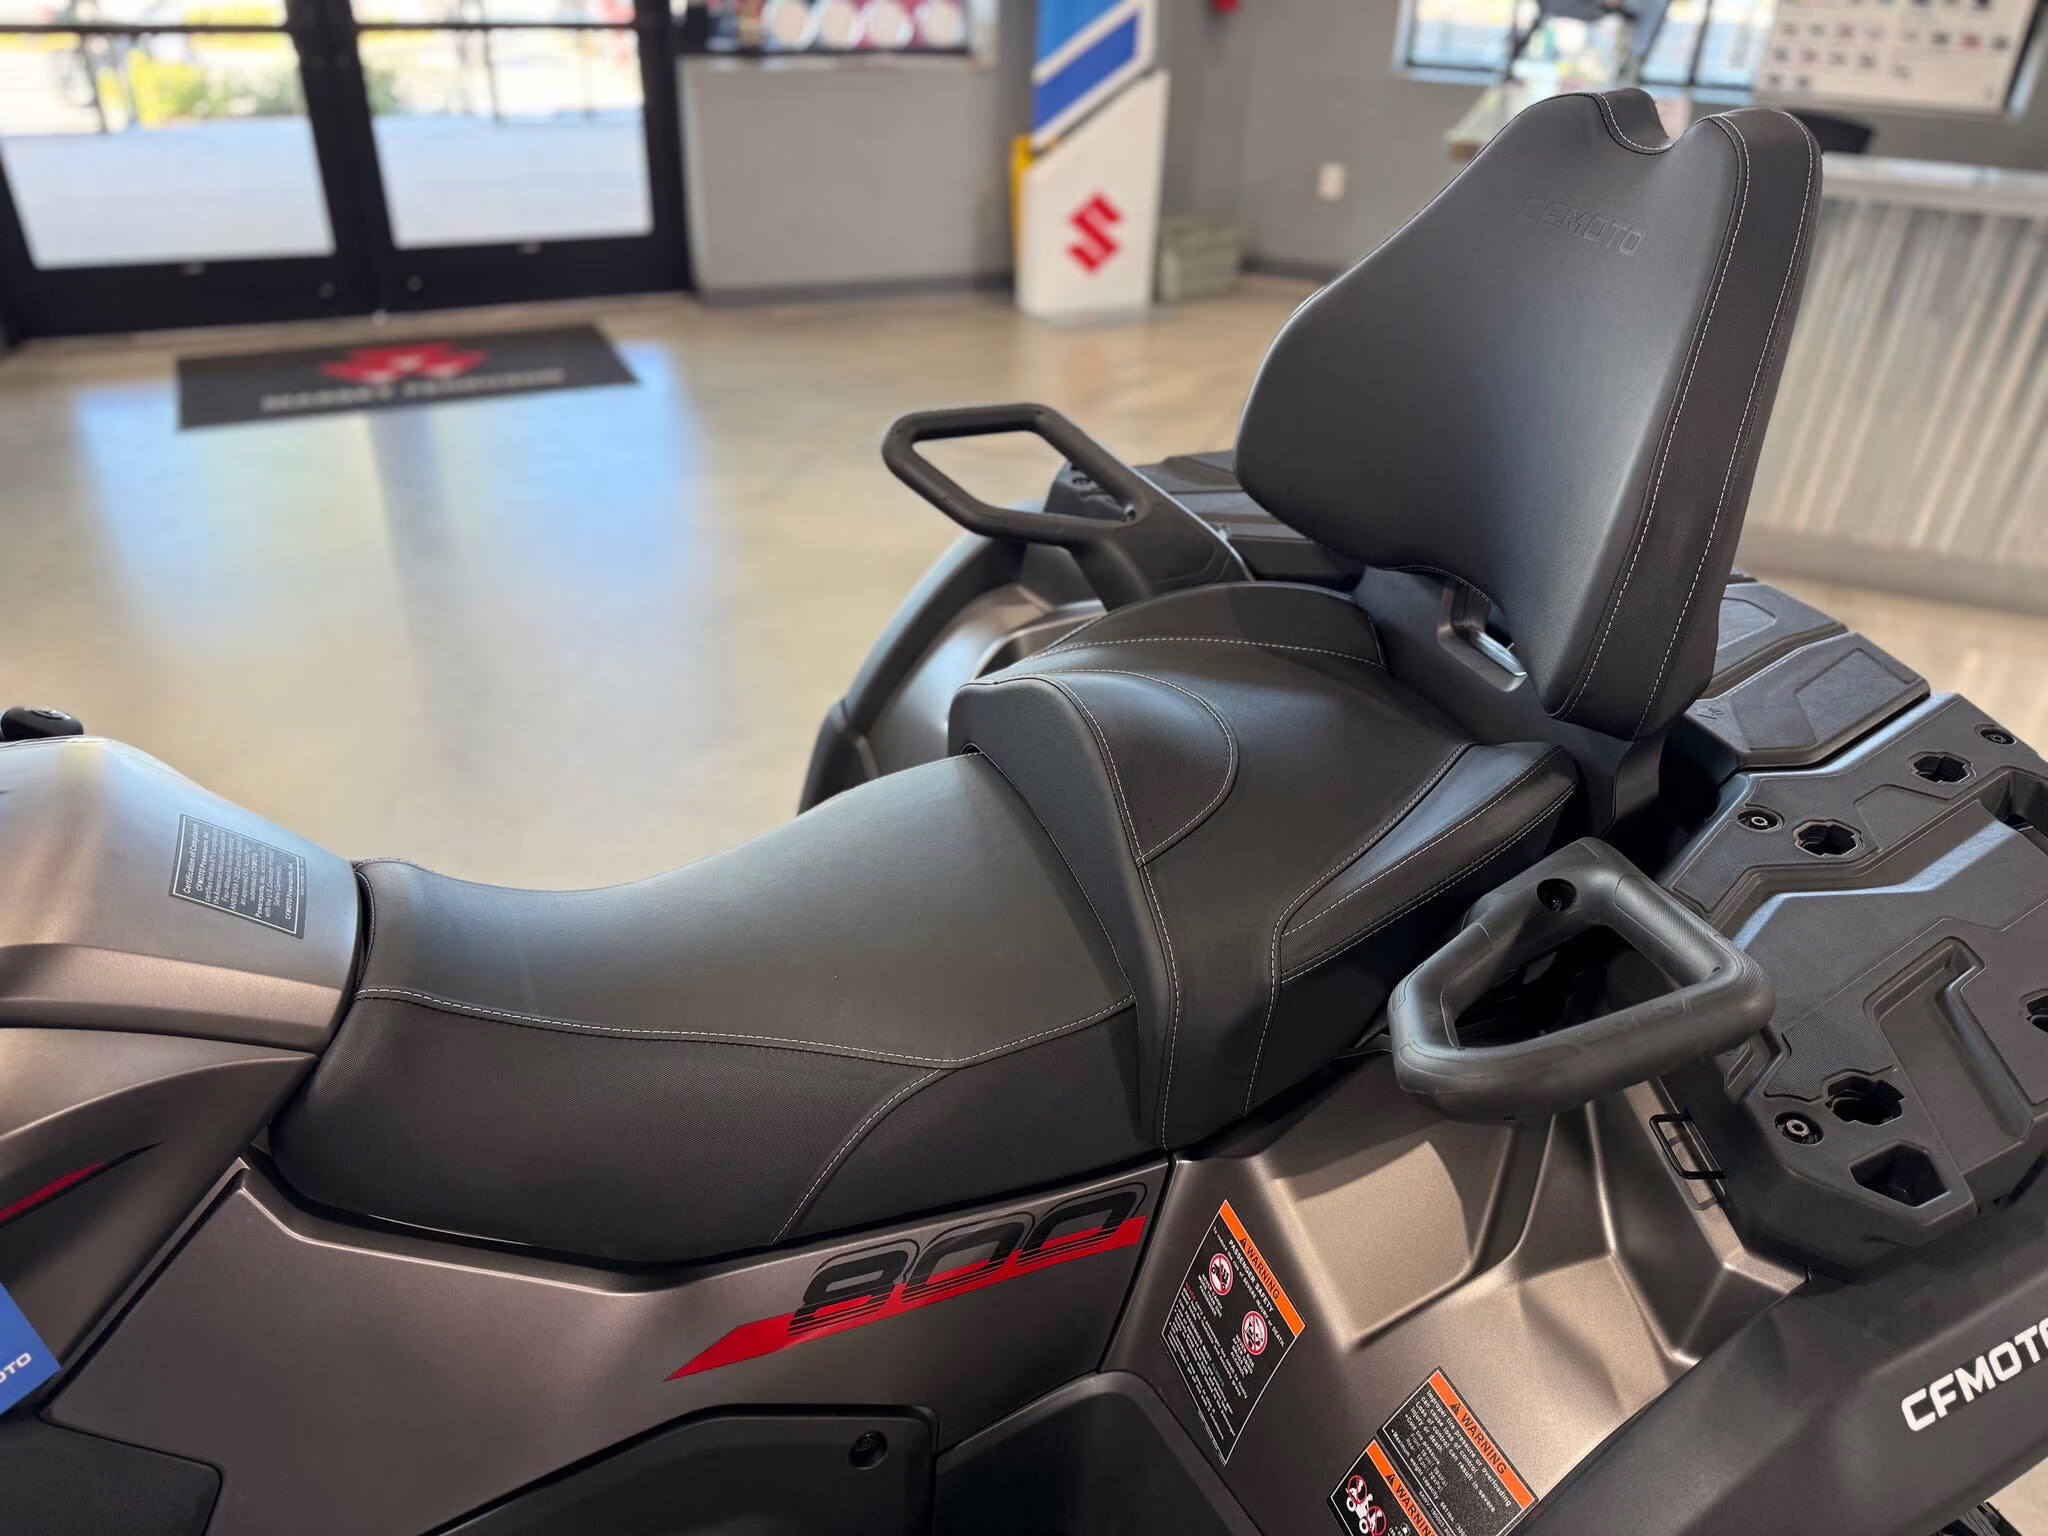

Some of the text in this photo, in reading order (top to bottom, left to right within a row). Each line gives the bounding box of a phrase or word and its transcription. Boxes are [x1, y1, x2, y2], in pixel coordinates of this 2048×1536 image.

[1518, 195, 1647, 257] CFMOTO
[183, 855, 195, 894] Certification
[195, 867, 205, 892] CFMOTO
[1228, 1238, 1274, 1314] PASSENGER SAFETY
[1242, 1275, 1257, 1300] SEVERE
[1255, 1297, 1269, 1321] INJURY
[1246, 1244, 1280, 1301] WARNING
[1901, 1316, 2048, 1431] CFMOT
[1420, 1395, 1431, 1409] can
[1428, 1407, 1444, 1427] cause
[1442, 1425, 1455, 1442] loss
[1452, 1439, 1462, 1451] of
[1424, 1389, 1448, 1419] Improper
[1445, 1416, 1456, 1430] tire
[1453, 1429, 1477, 1459] pressure
[1479, 1465, 1513, 1508] overloading
[1459, 1412, 1508, 1475] WARNING
[1391, 1430, 1412, 1457] Maximum
[1407, 1456, 1424, 1477] weight
[1414, 1400, 1428, 1418] Loss
[1425, 1415, 1434, 1426] of
[1431, 1424, 1450, 1449] control
[1447, 1447, 1459, 1462] can
[1456, 1460, 1474, 1481] result
[1477, 1489, 1496, 1513] severe
[1421, 1439, 1441, 1465] pressure
[1396, 1486, 1437, 1536] WARNIN
